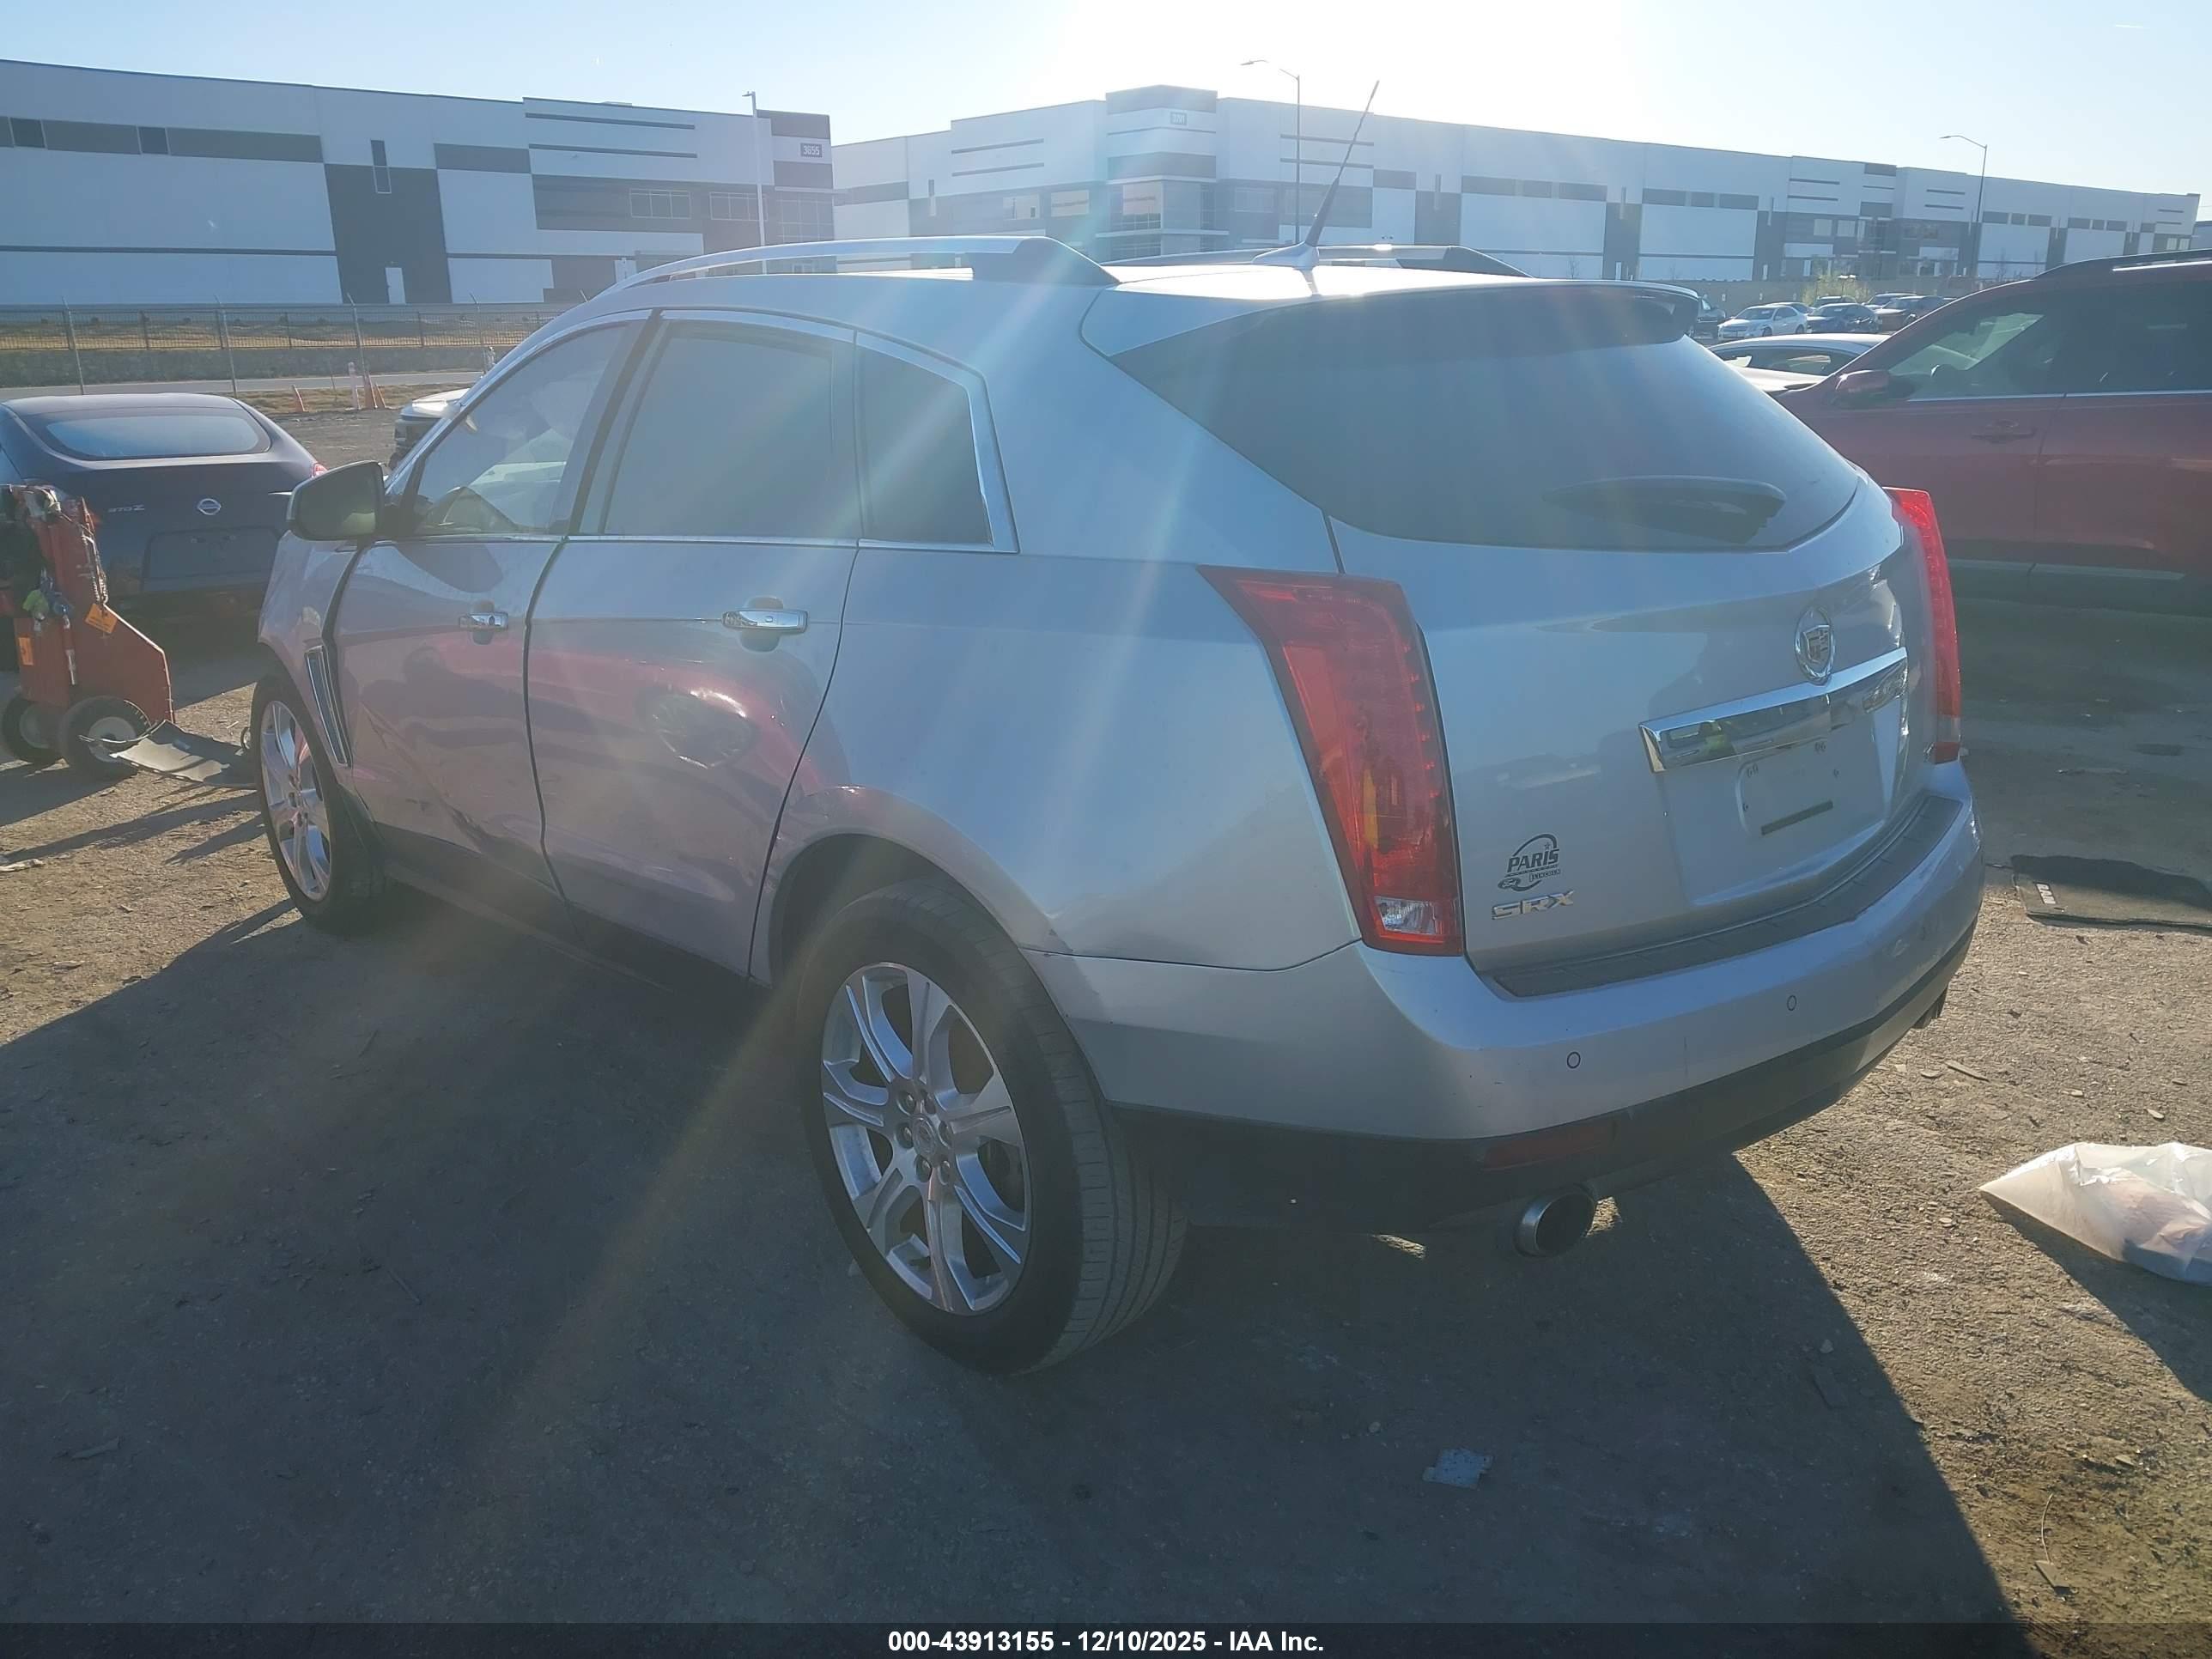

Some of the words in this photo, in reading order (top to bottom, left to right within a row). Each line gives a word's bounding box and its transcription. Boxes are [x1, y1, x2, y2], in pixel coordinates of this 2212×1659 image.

[803, 144, 820, 155] 3655
[1506, 848, 1560, 873] PARIS
[1492, 890, 1574, 921] SRX
